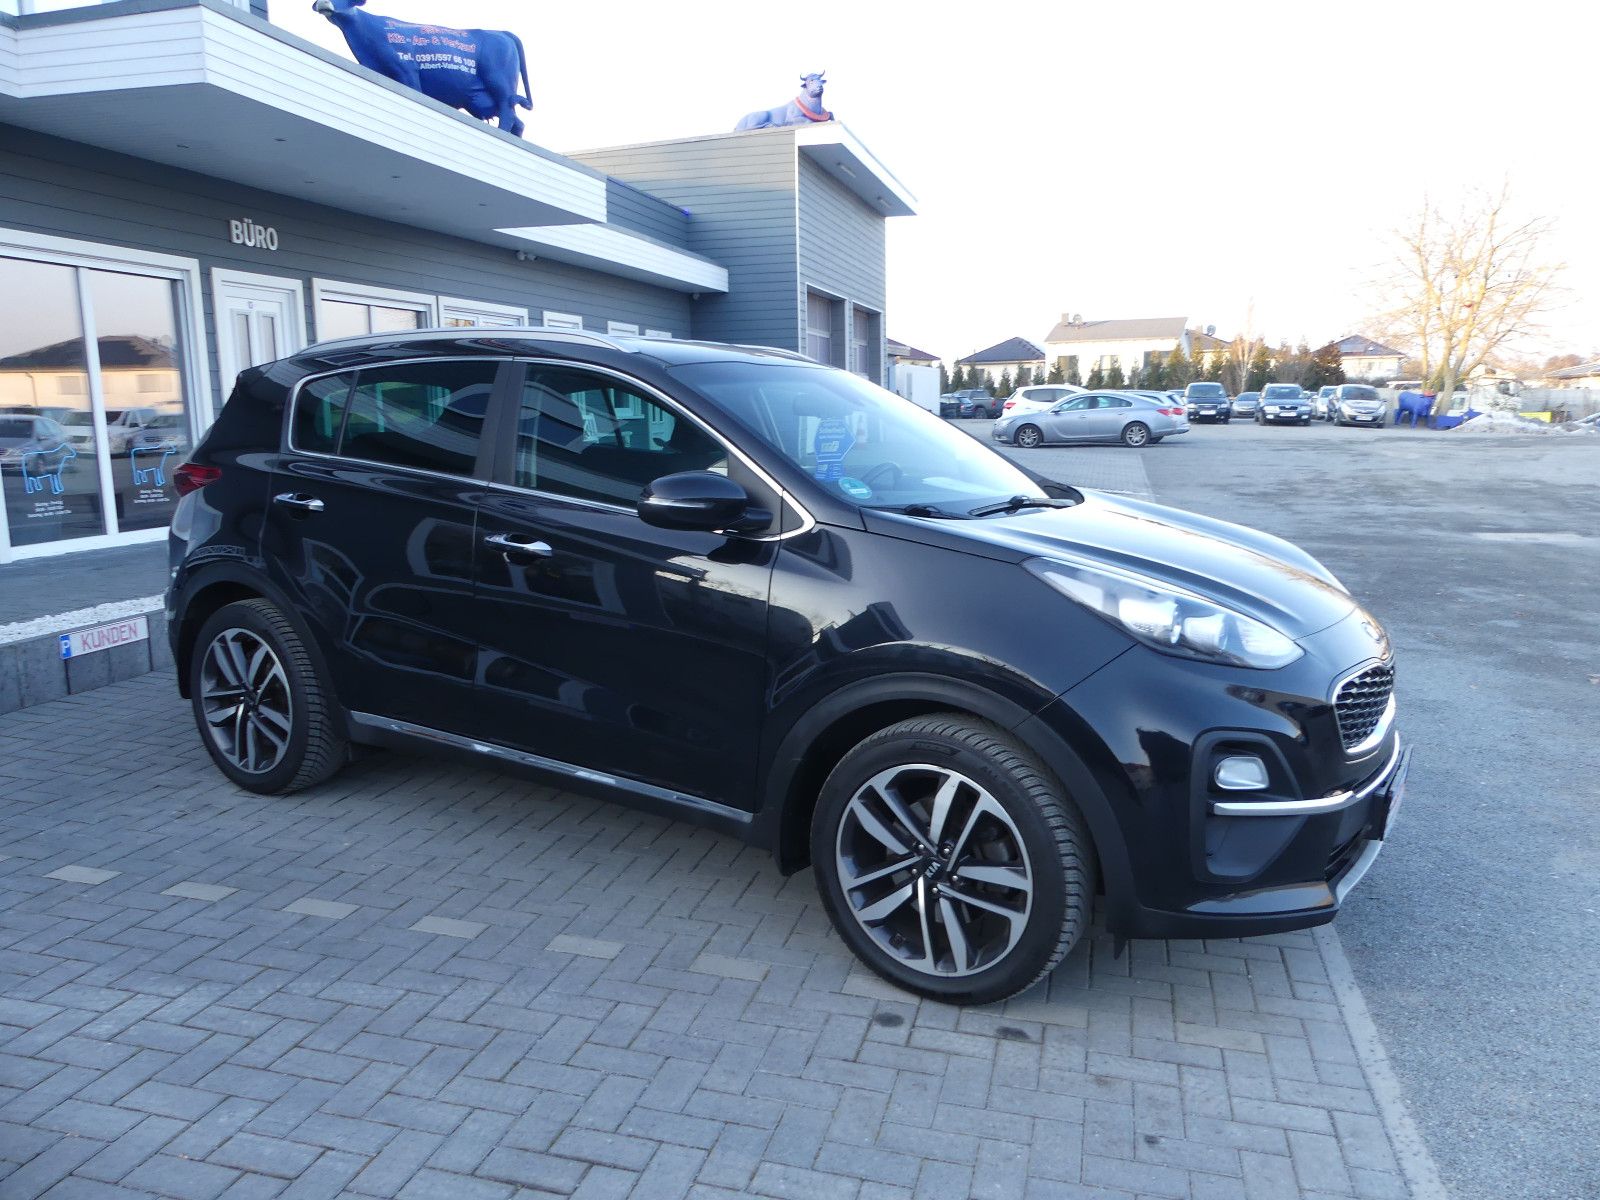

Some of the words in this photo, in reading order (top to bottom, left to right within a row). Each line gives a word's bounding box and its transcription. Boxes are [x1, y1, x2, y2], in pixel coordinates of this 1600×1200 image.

[397, 52, 414, 61] Tel.
[230, 217, 279, 251] BÜRO
[62, 639, 70, 655] P
[80, 622, 139, 651] KUNDEN
[924, 861, 941, 878] KIA
